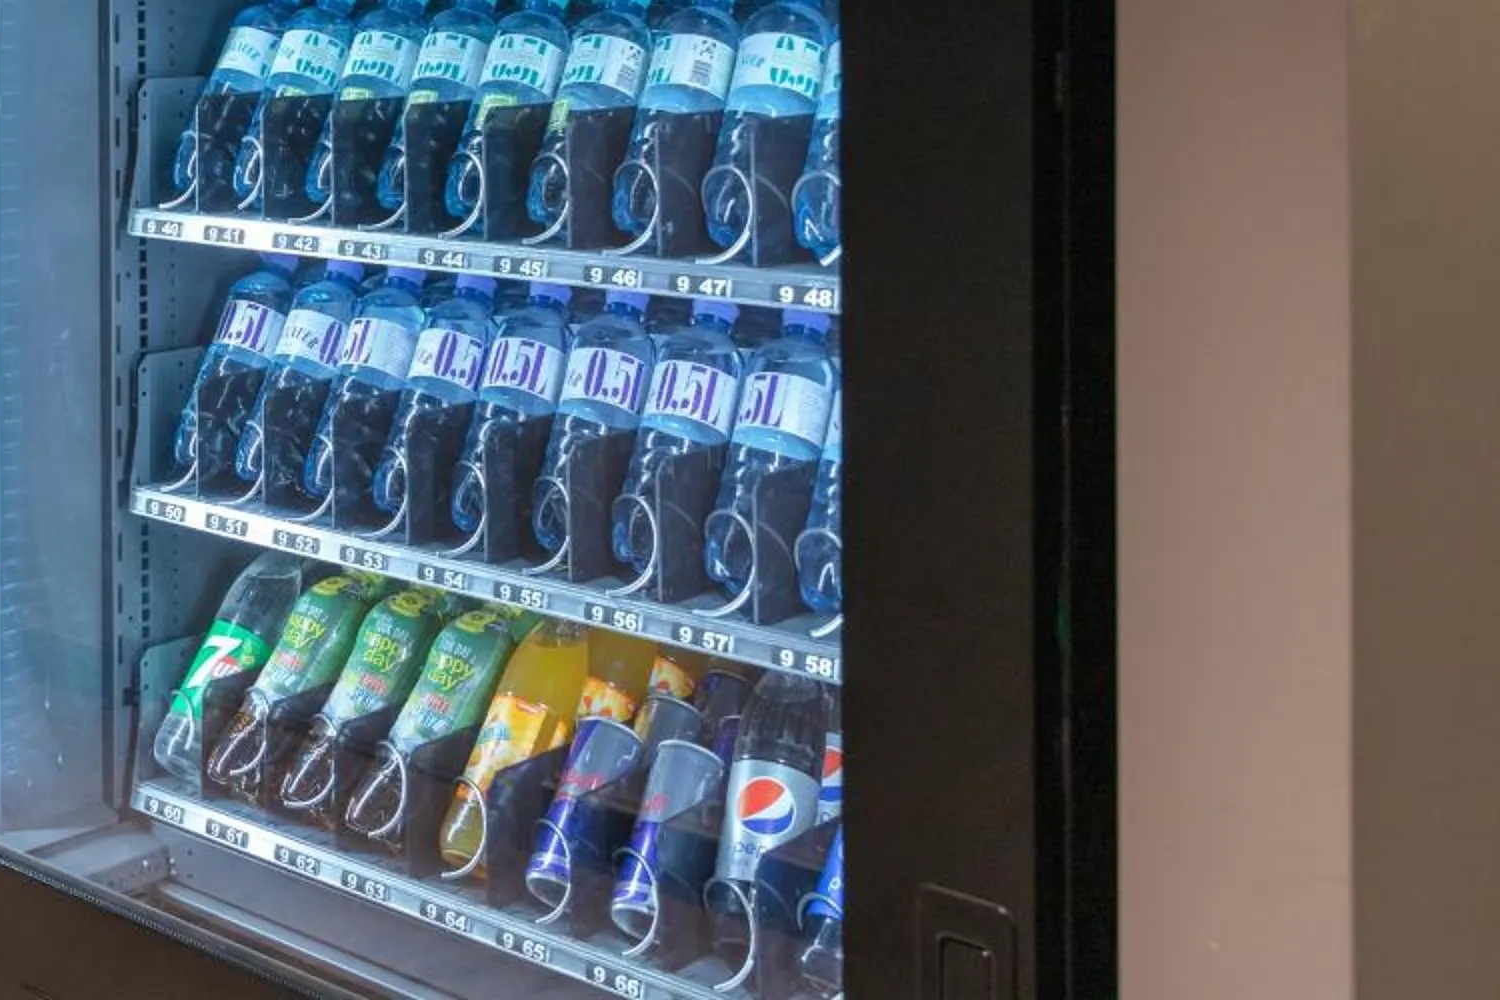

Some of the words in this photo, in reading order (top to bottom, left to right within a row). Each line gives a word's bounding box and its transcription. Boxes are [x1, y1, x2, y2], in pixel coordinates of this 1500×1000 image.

[147, 221, 156, 234] 9
[161, 222, 179, 236] 40
[209, 227, 218, 240] 9
[221, 229, 239, 243] 41
[277, 235, 287, 249] 9
[293, 236, 313, 251] 42
[344, 242, 354, 255] 9
[361, 244, 381, 259] 43
[424, 251, 435, 264] 9
[442, 252, 464, 267] 44
[500, 258, 511, 272] 9
[519, 260, 542, 276] 45
[591, 268, 602, 282] 9
[612, 270, 636, 286] 46
[677, 277, 690, 292] 9
[699, 280, 726, 296] 47
[779, 287, 793, 303] 9
[803, 289, 832, 307] 48
[655, 362, 719, 425] 0.5L
[151, 501, 160, 515] 9
[165, 504, 182, 519] 50
[211, 516, 220, 529] 9
[225, 520, 243, 534] 51
[278, 532, 287, 545] 9
[294, 536, 312, 551] 52
[344, 548, 354, 562] 9
[364, 552, 382, 567] 53
[424, 567, 435, 581] 9
[444, 572, 464, 587] 54
[500, 585, 510, 600] 9
[520, 589, 542, 607] 55
[592, 606, 603, 621] 9
[614, 611, 636, 629] 56
[680, 627, 692, 643] 9
[703, 632, 728, 650] 57
[780, 650, 794, 666] 9
[806, 655, 832, 675] 58
[149, 799, 159, 813] 9
[163, 804, 181, 820] 60
[211, 822, 220, 836] 9
[225, 827, 243, 843] 61
[280, 848, 289, 862] 9
[296, 854, 315, 870] 62
[347, 873, 357, 888] 9
[365, 880, 384, 896] 63
[426, 903, 437, 918] 9
[445, 911, 466, 928] 64
[503, 933, 514, 949] 9
[522, 940, 544, 960] 65
[594, 965, 605, 982] 9
[615, 973, 639, 994] 66
